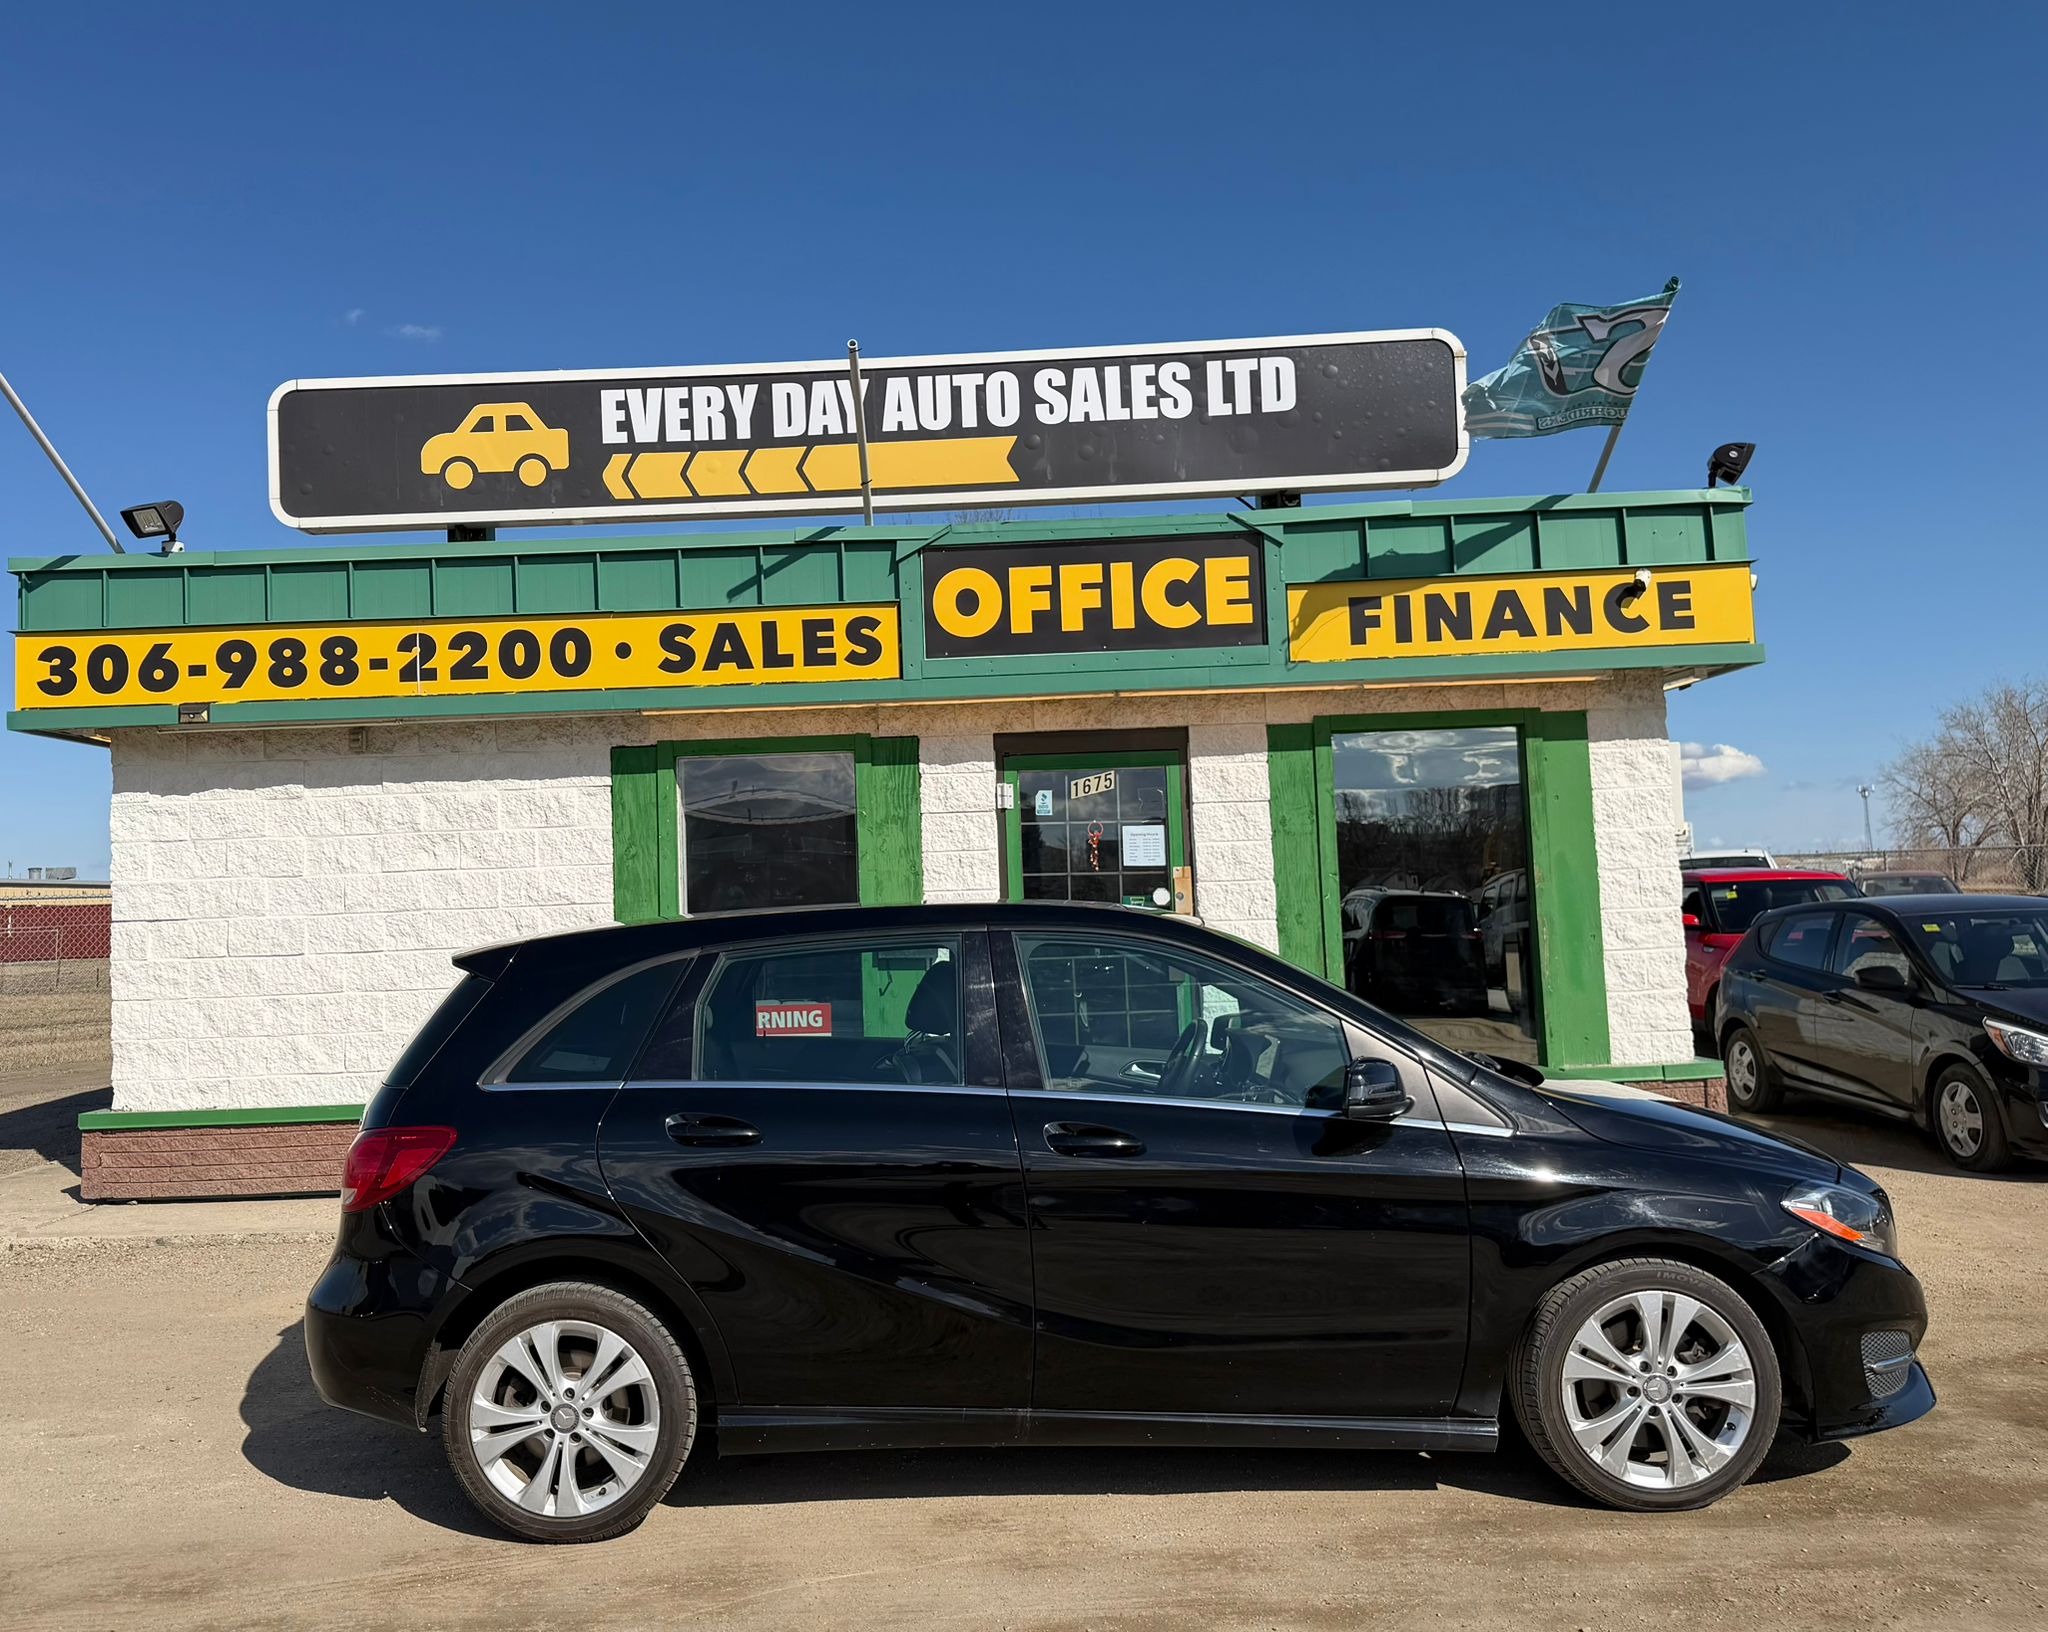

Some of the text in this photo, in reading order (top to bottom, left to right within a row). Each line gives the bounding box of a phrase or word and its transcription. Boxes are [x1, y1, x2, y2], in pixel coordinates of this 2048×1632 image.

[600, 356, 1297, 444] EVERY DAY AUTO SALES LTD
[932, 555, 1254, 639] OFFICE
[1348, 580, 1696, 646] FINANCE
[35, 615, 884, 697] 306-988-2200 SALES
[1073, 772, 1113, 797] 1675
